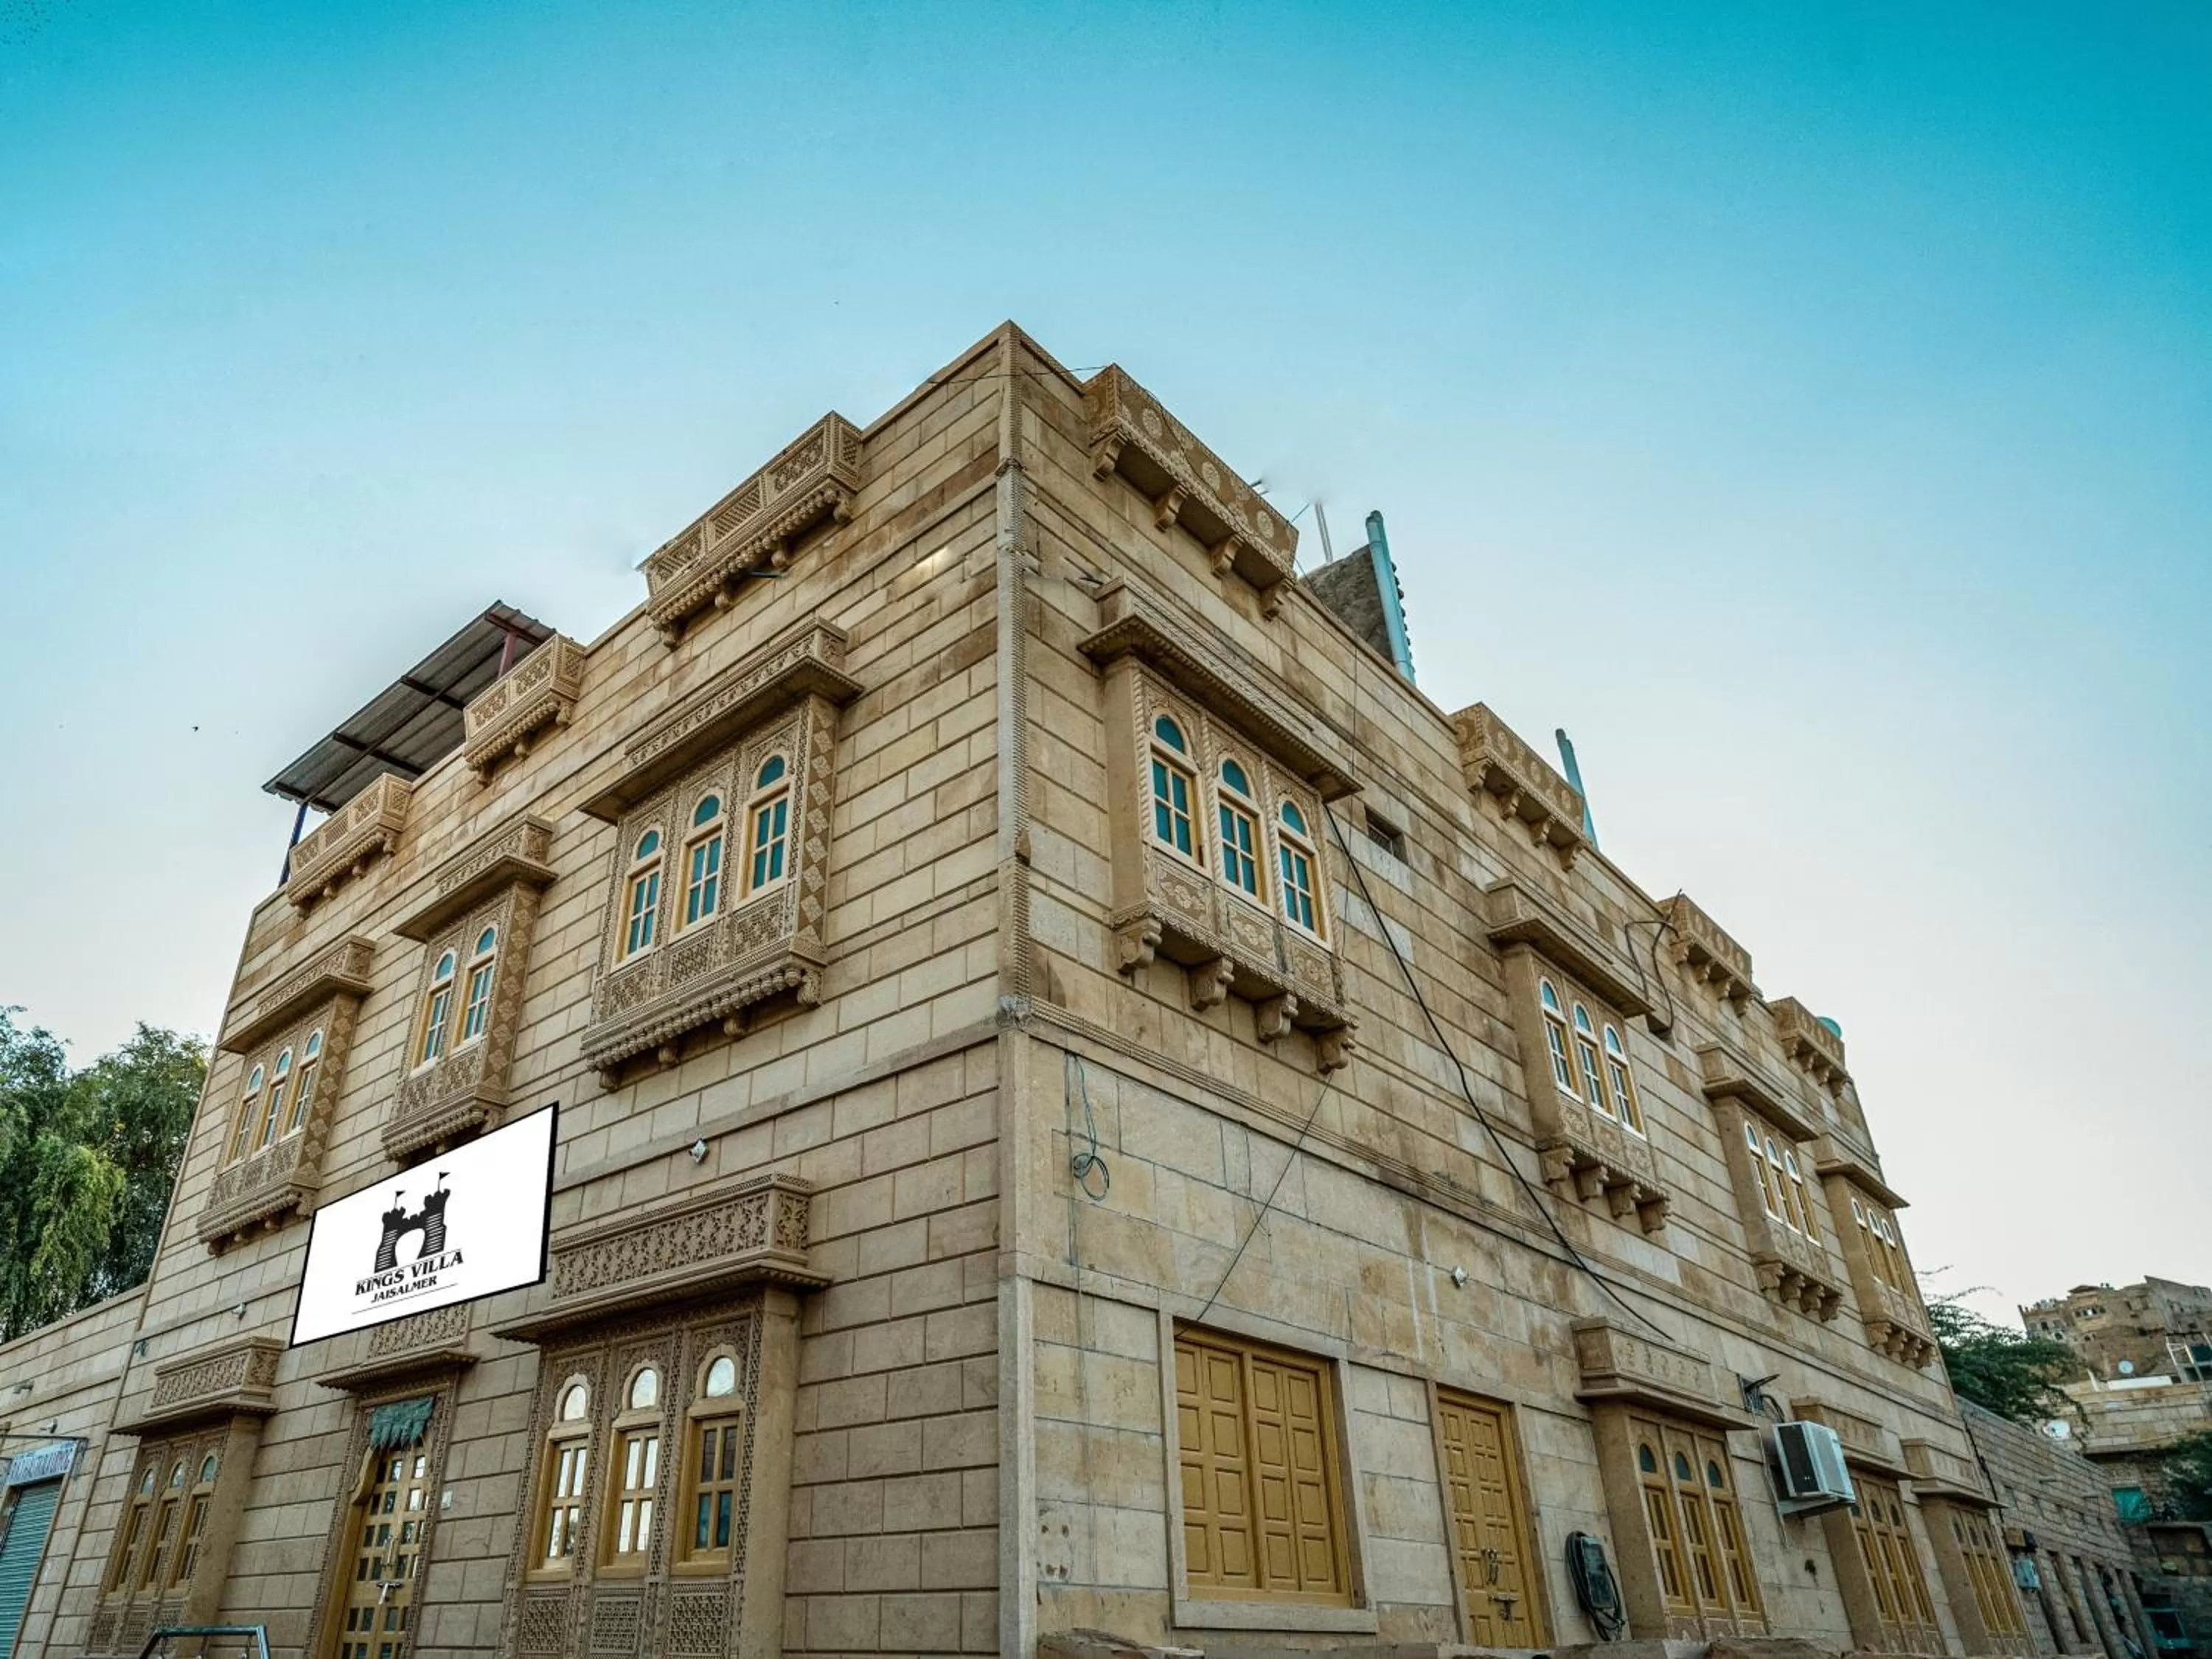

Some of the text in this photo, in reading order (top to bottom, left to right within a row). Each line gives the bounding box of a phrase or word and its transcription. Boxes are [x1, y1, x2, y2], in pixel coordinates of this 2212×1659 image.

[355, 1252, 463, 1295] KINGS VILLA
[372, 1276, 437, 1303] JAISALMER
